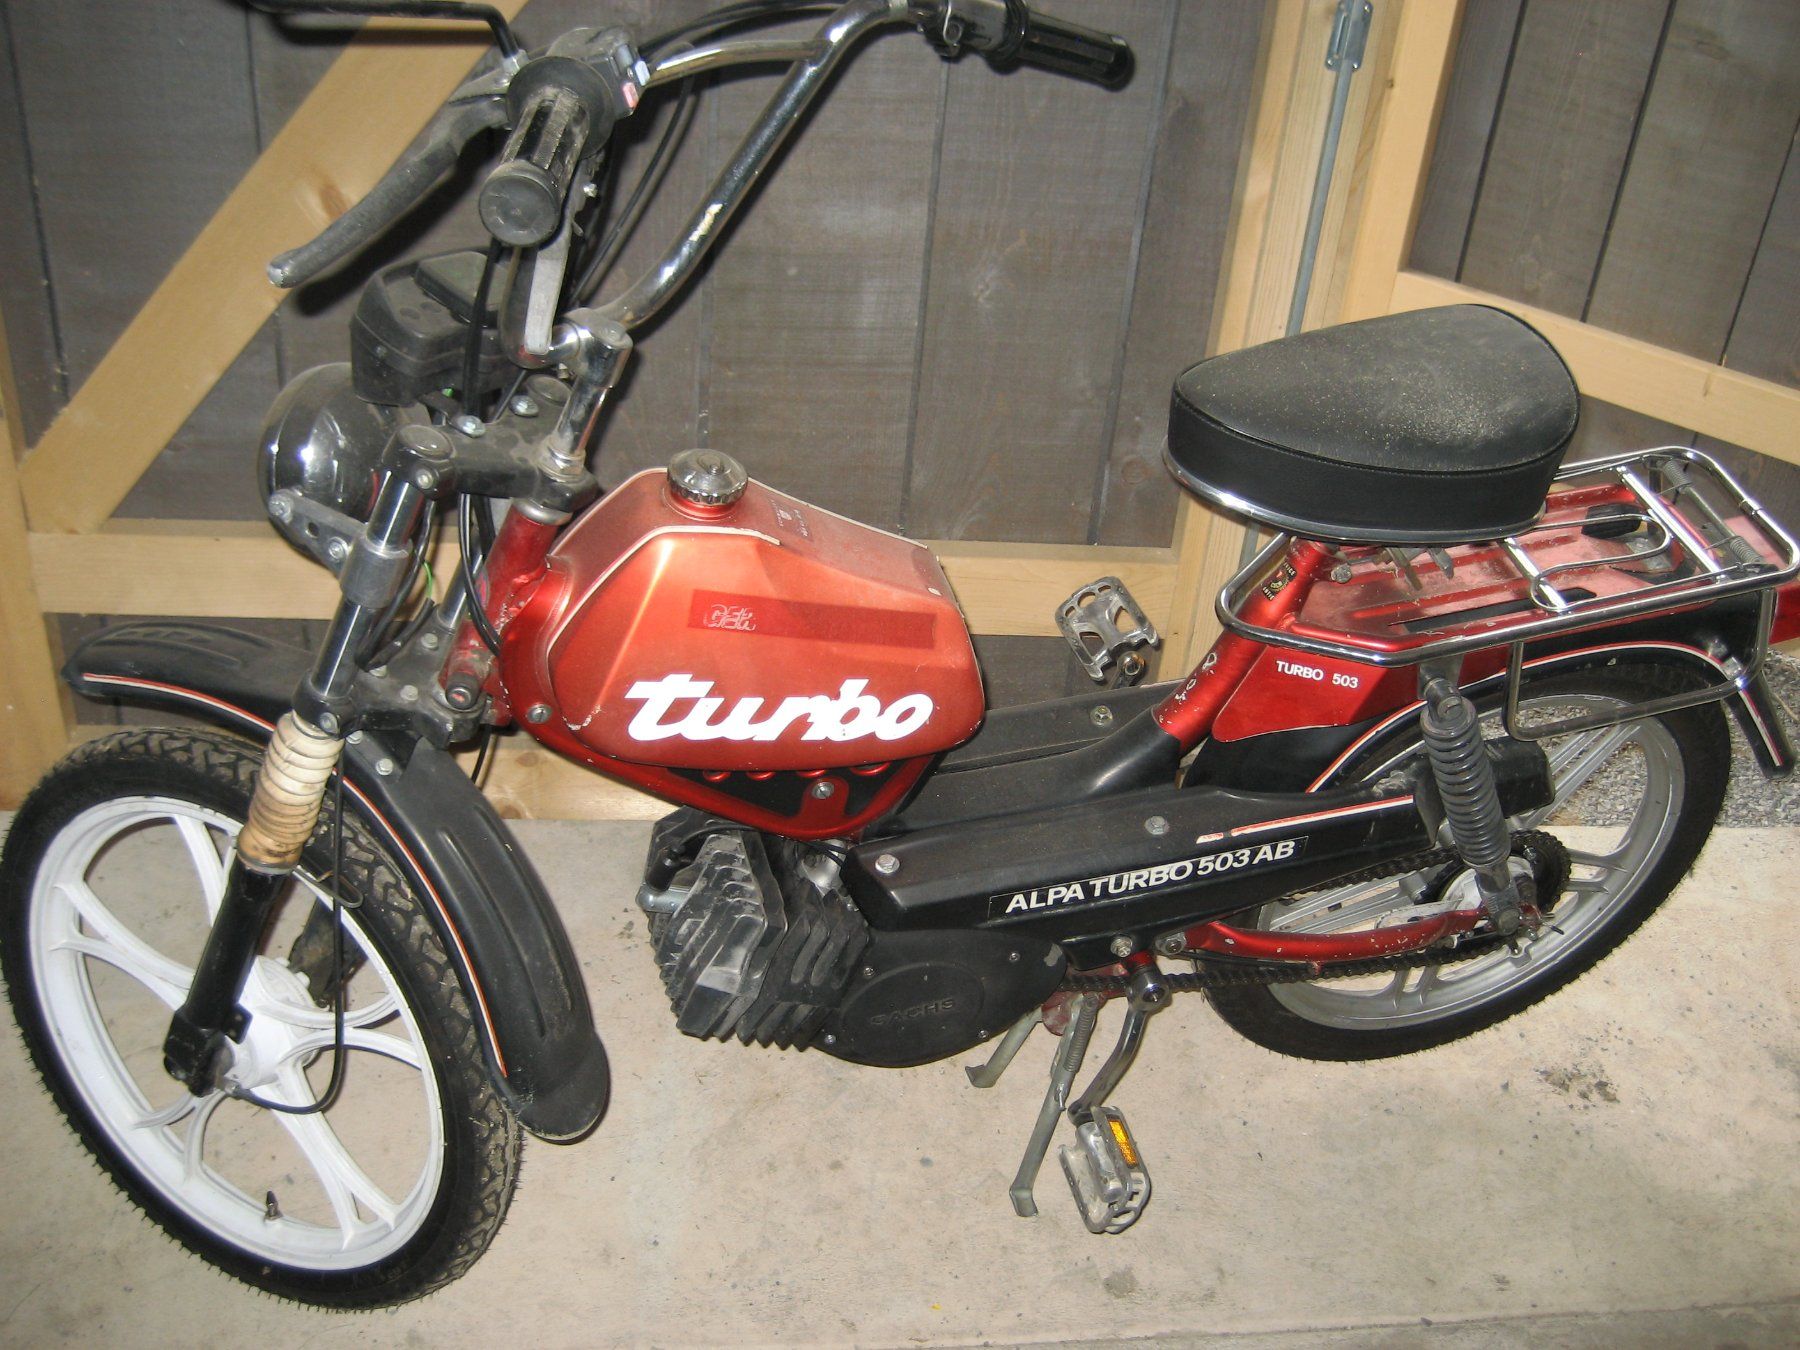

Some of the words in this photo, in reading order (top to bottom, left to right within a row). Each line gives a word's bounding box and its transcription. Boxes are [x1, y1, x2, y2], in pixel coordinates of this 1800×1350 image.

[1276, 660, 1324, 681] TURBO
[1331, 673, 1359, 689] 503
[624, 674, 935, 742] turbo
[1005, 882, 1085, 914] ALPA
[1089, 859, 1194, 898] TURBO
[1196, 848, 1251, 876] 503
[1251, 840, 1297, 865] AB
[870, 999, 954, 1026] SACHS
